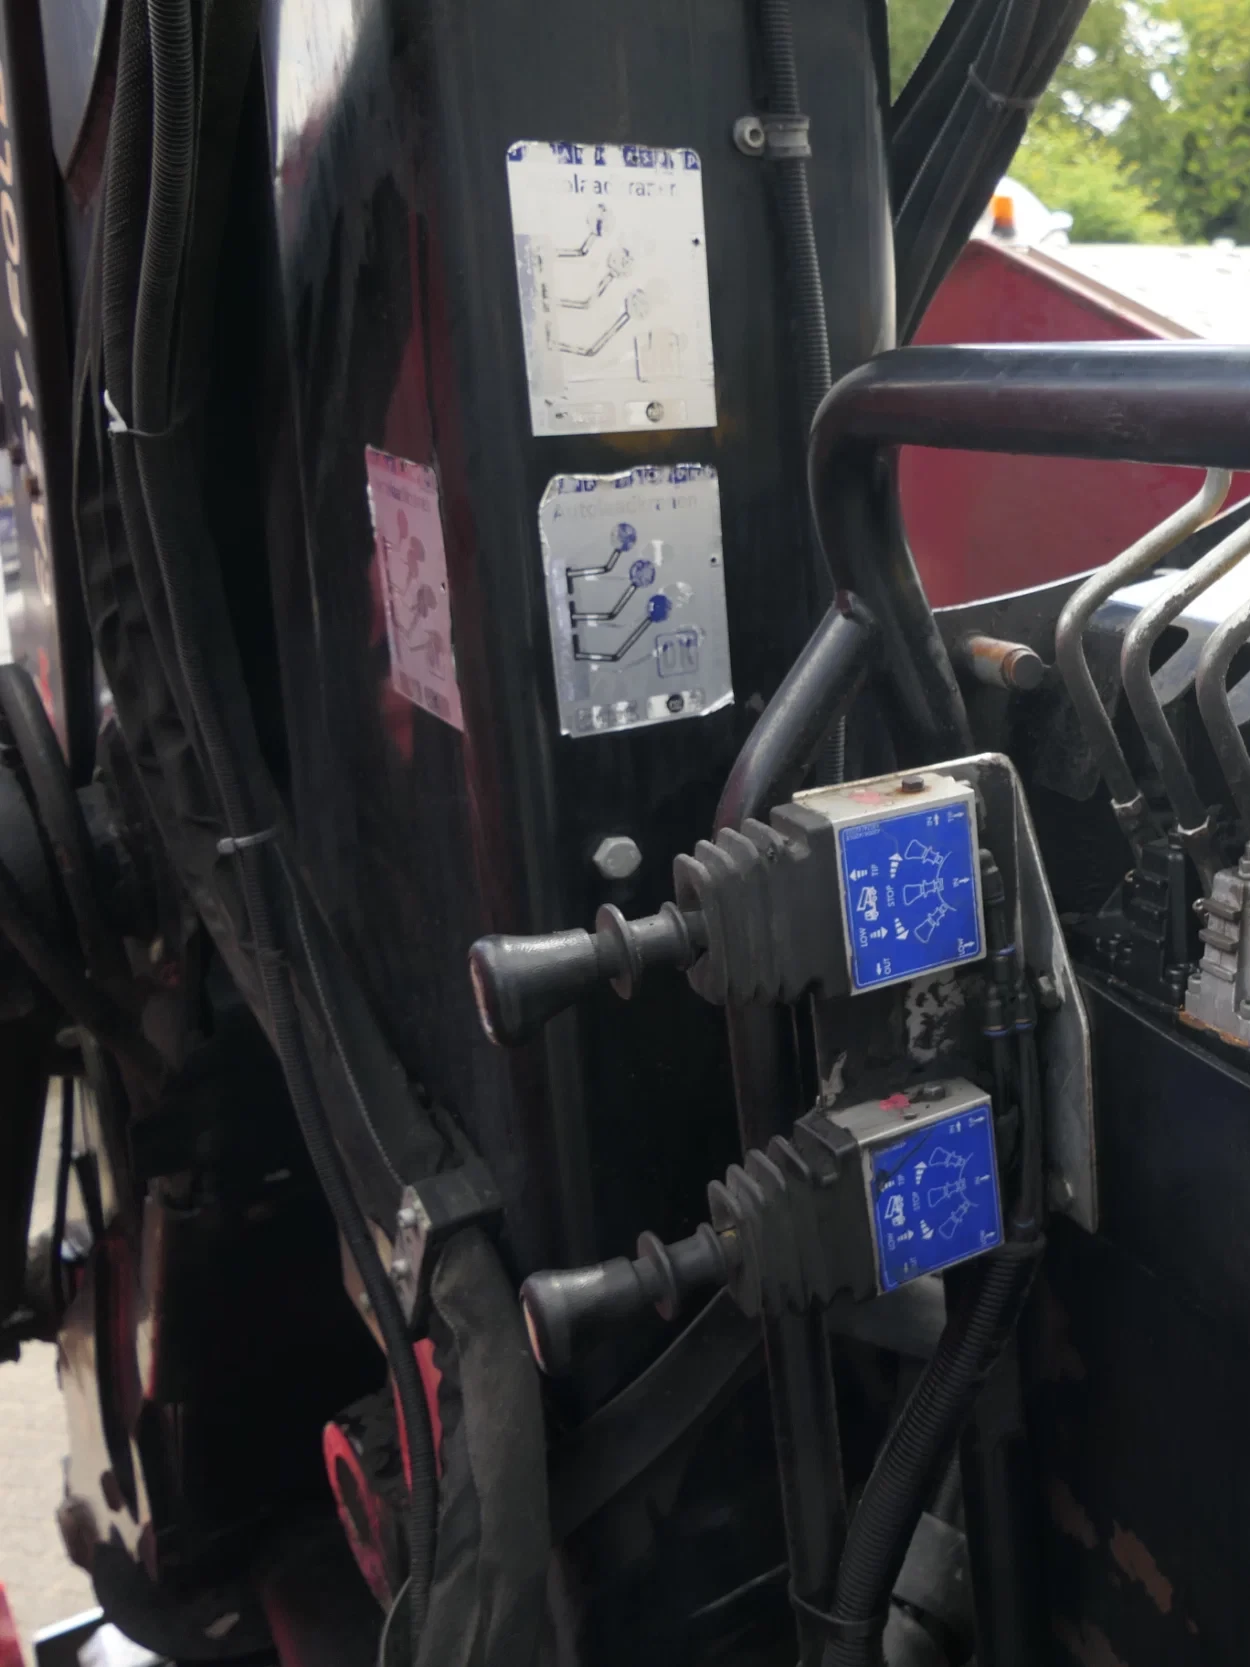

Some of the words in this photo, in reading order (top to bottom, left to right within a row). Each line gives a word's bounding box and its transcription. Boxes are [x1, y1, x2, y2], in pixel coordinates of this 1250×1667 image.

[870, 864, 878, 877] TIP
[886, 885, 896, 907] STOP
[860, 927, 868, 948] LOW
[957, 938, 965, 956] LOW
[883, 957, 892, 975] OUT
[897, 1174, 906, 1187] TIP
[912, 1191, 921, 1211] STOP
